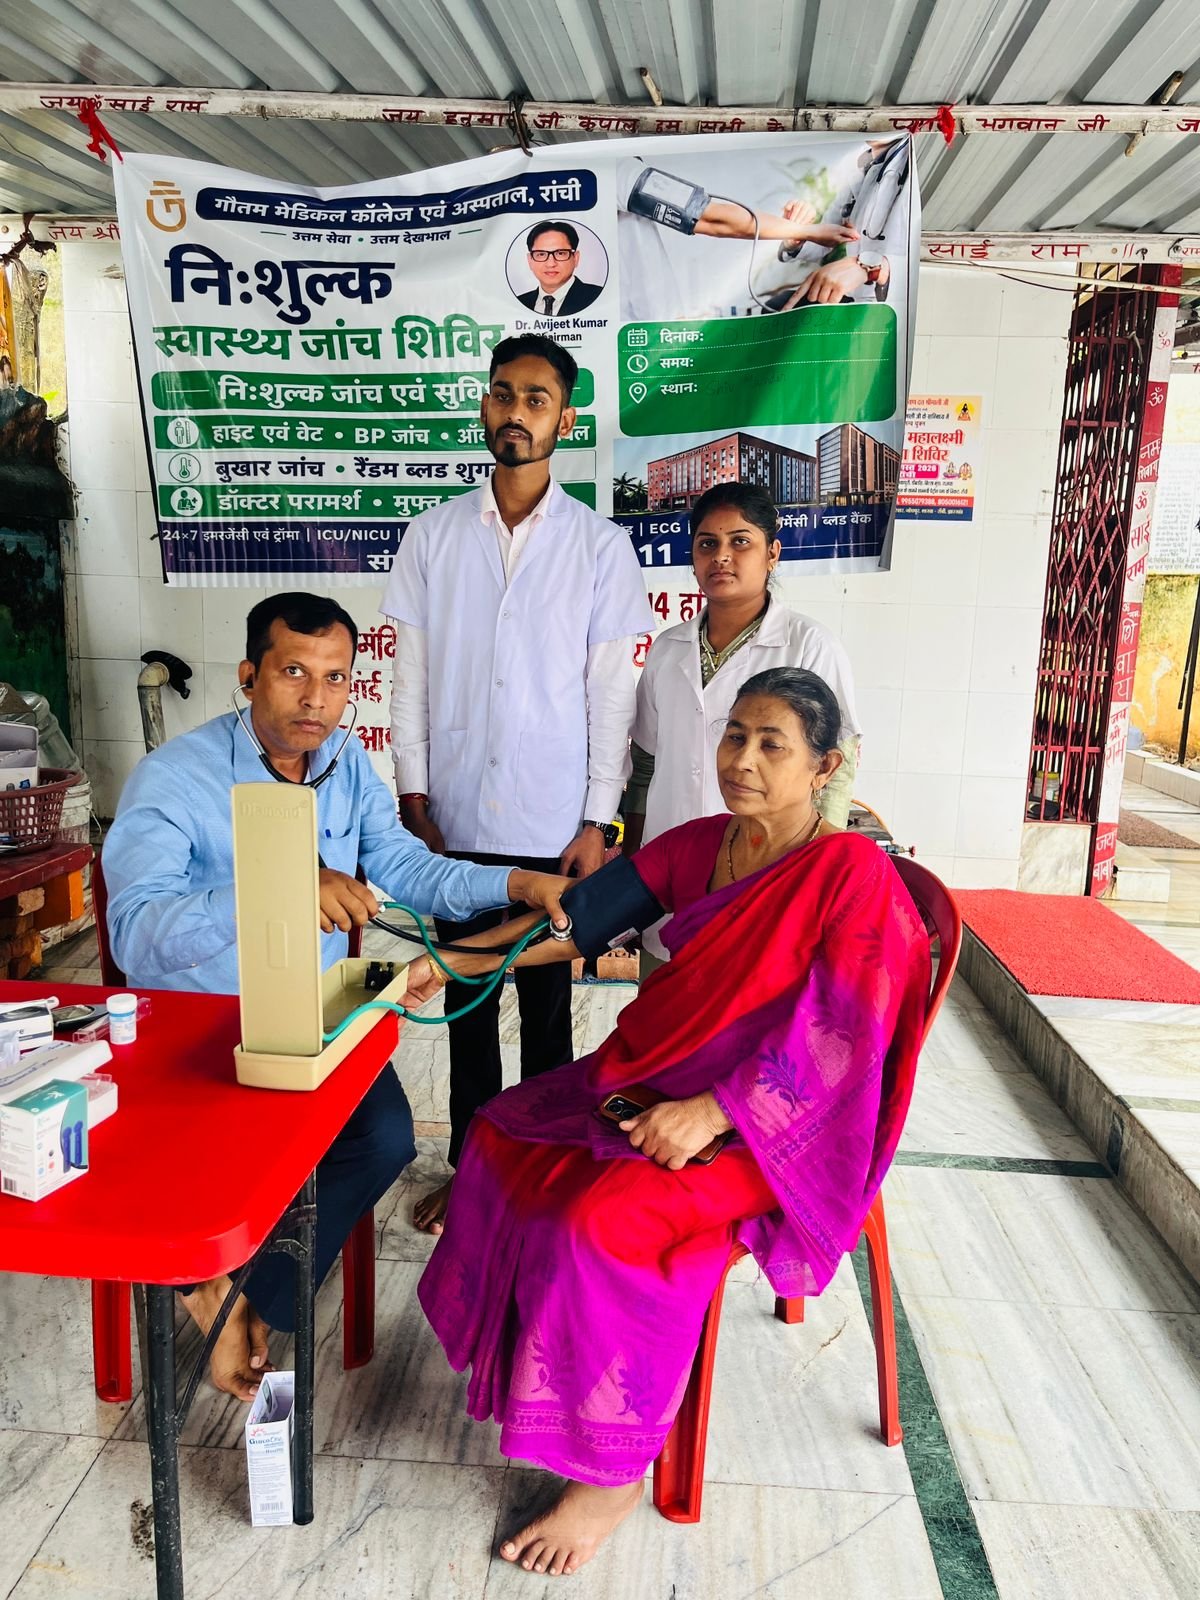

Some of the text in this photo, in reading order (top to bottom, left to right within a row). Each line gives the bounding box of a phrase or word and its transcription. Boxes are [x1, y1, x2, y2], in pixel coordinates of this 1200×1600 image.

[40, 96, 84, 109] जय
[166, 99, 208, 113] राम
[382, 108, 425, 123] जय
[533, 111, 566, 129] जी
[976, 118, 1066, 131] भगवान
[1078, 114, 1110, 131] जी
[215, 178, 582, 223] गौतम मेडिकल कॉलेज एवं अस्पताल, रांची
[48, 223, 120, 240] जय श्री
[292, 230, 451, 245] उत्तम सेवा उत्तम देखभाल
[1031, 243, 1089, 259] राम
[515, 318, 608, 332] Dr. Avijeet Kumar
[152, 313, 505, 360] स्वास्थ्य जांच शिविर
[331, 378, 382, 404] जांच
[389, 377, 426, 407] एवं
[1147, 386, 1163, 407] ॐ
[212, 424, 255, 443] हाइट
[261, 422, 290, 443] एवं
[296, 422, 323, 443] वेट
[355, 429, 386, 444] BP
[392, 424, 430, 445] जांच
[908, 429, 963, 444] महालक्ष्मी
[913, 445, 948, 460] शिविर
[215, 461, 271, 483] बुखार
[278, 456, 325, 477] जांच
[354, 457, 399, 478] रैंडम
[405, 462, 448, 478] ब्लड
[217, 488, 281, 511] डॉक्टर
[287, 489, 363, 511] परामर्श
[1134, 490, 1149, 510] ॐ
[822, 515, 848, 526] ब्लड
[851, 511, 873, 525] बैंक
[202, 527, 249, 541] इमरजेंसी
[253, 528, 271, 541] एवं
[273, 527, 300, 543] ट्रॉमा
[318, 529, 390, 542] ICU/NICU
[650, 522, 681, 534] ECG
[1095, 832, 1117, 851] जय
